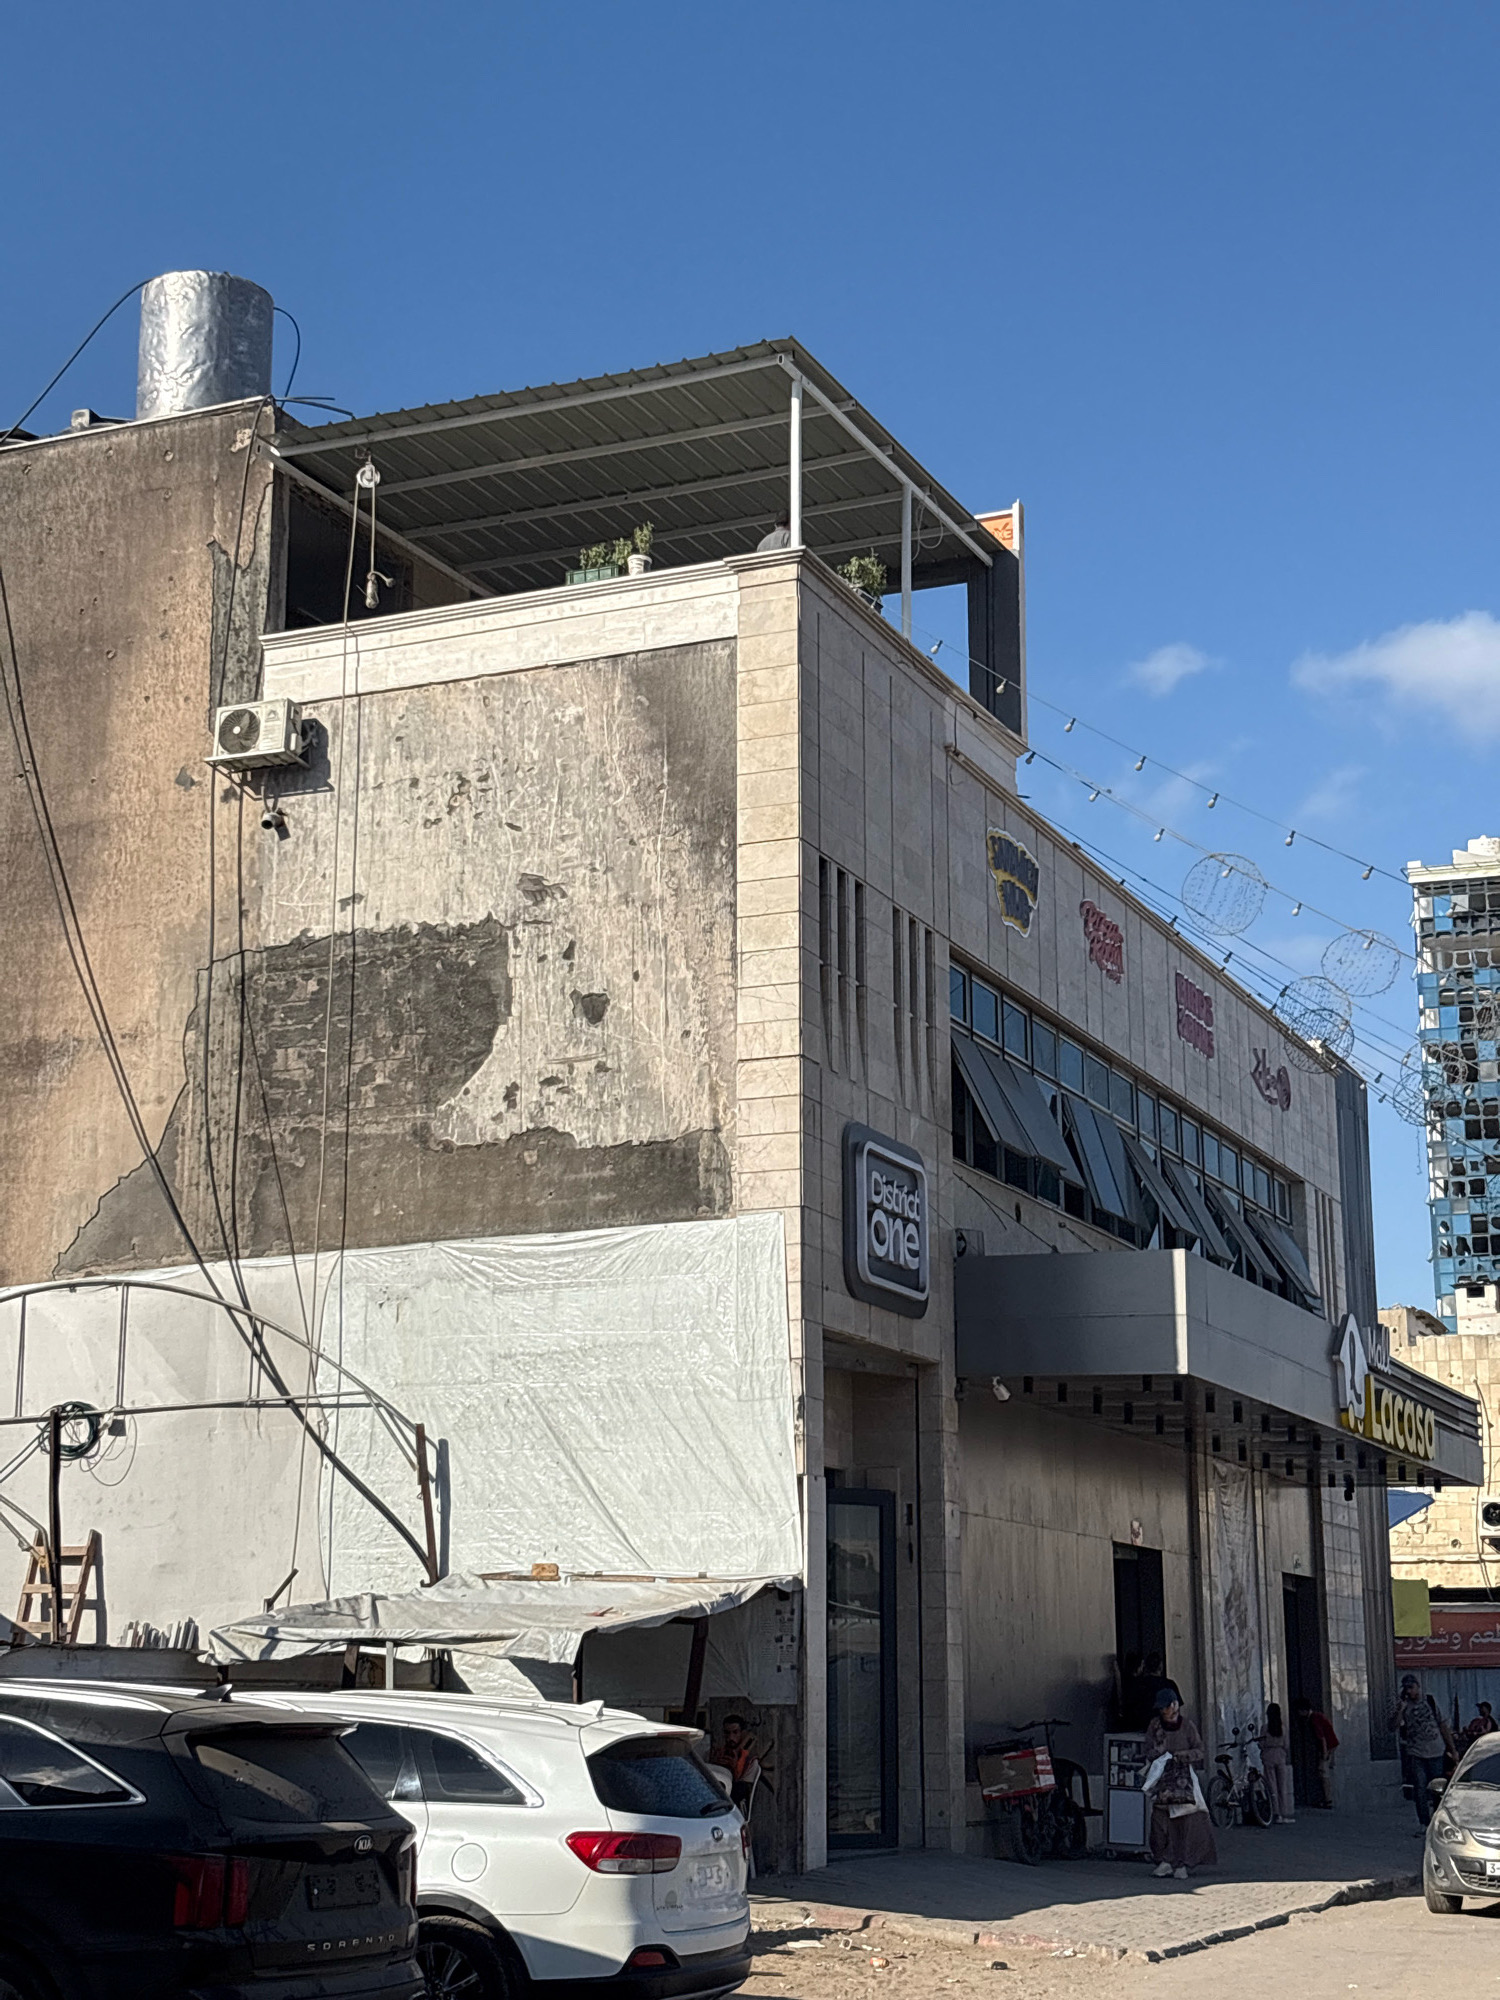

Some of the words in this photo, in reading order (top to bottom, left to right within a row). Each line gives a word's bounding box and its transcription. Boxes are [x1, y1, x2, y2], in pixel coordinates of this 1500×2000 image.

[871, 1170, 921, 1223] District
[1367, 1325, 1392, 1375] Mall
[1369, 1374, 1435, 1460] Lacasa
[307, 1934, 395, 1951] SORENTO
